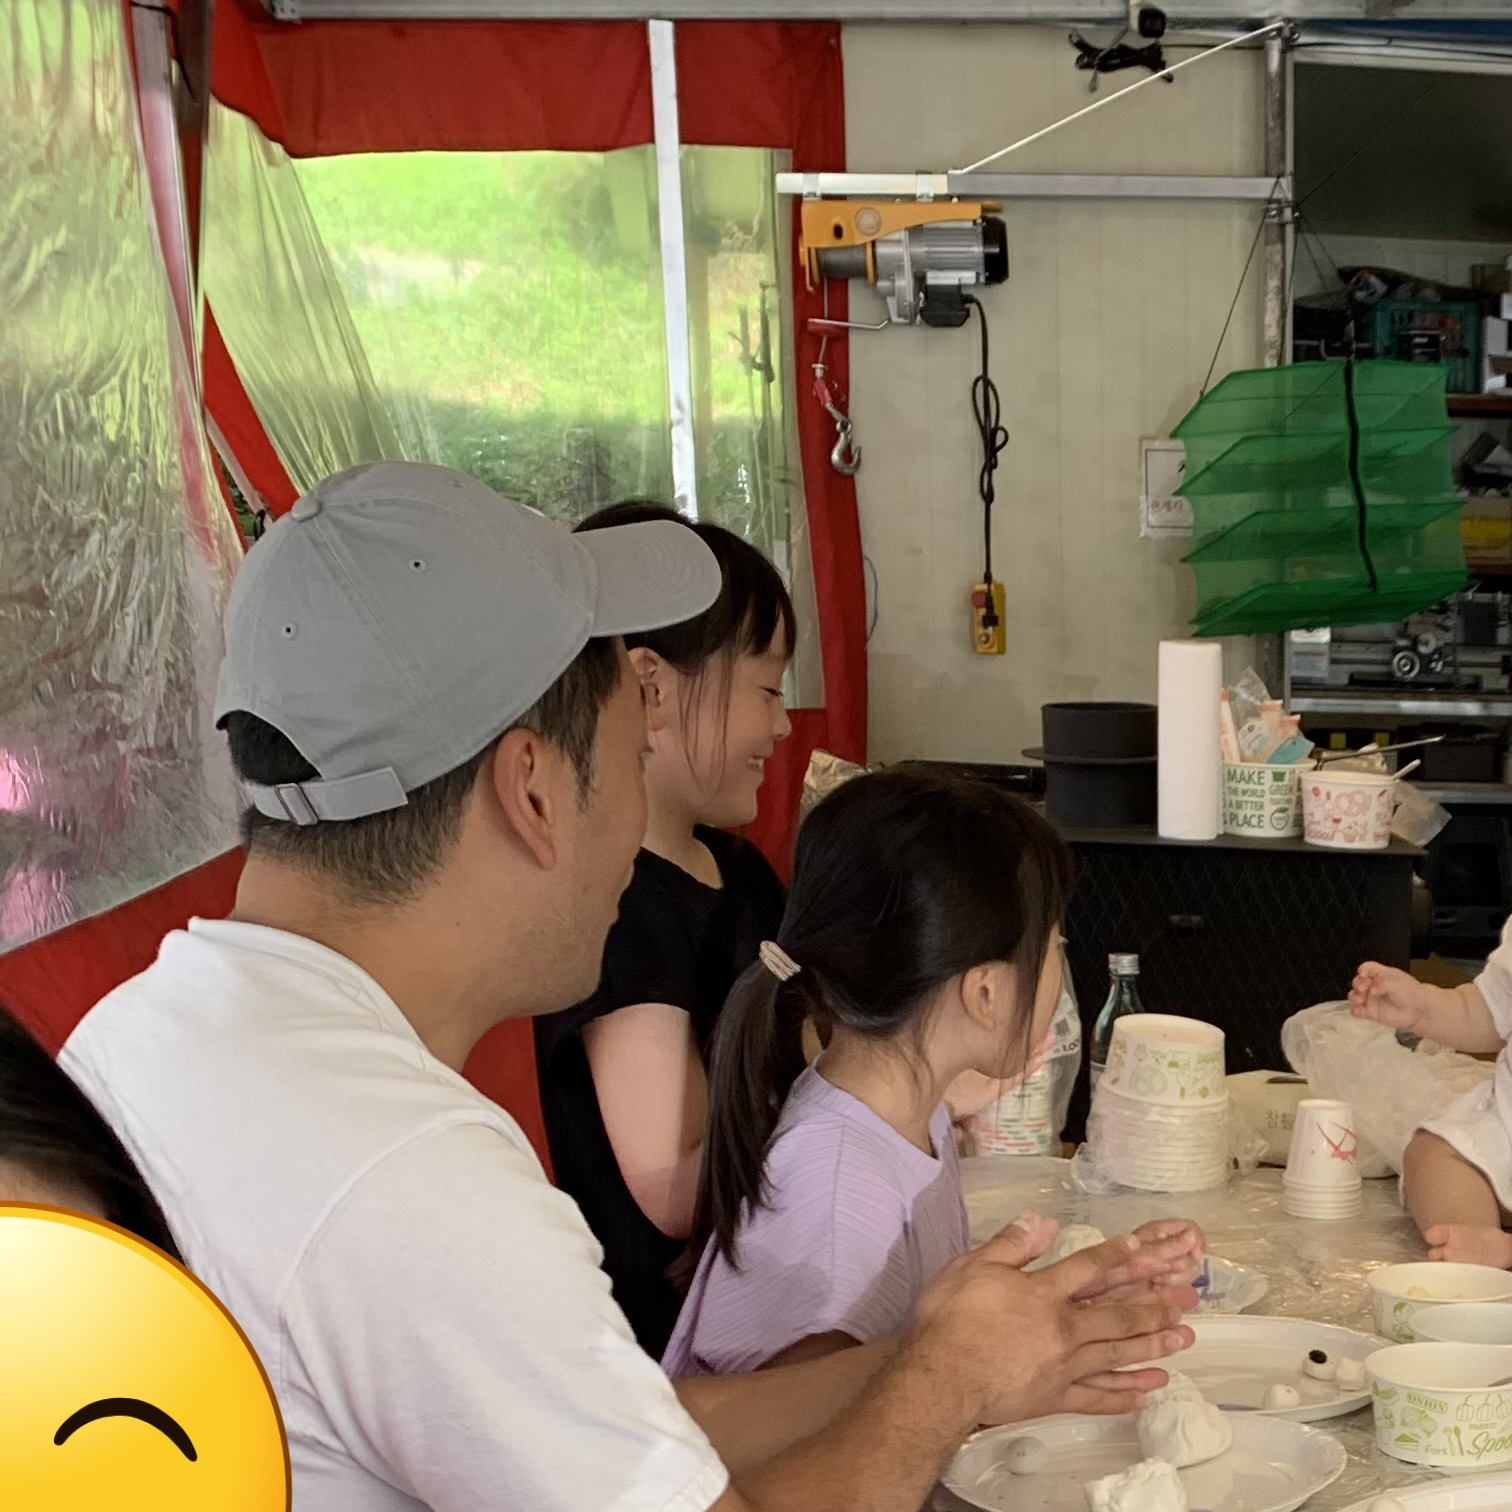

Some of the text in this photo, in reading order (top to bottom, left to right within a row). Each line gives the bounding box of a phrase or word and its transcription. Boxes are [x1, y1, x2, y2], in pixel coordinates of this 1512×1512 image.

[1227, 768, 1265, 786] MAKE
[1241, 788, 1266, 798] WORLD
[1235, 799, 1265, 811] BETTER
[1229, 812, 1265, 829] PLACE
[1407, 1391, 1446, 1412] ONION
[1425, 1444, 1449, 1457] Fork
